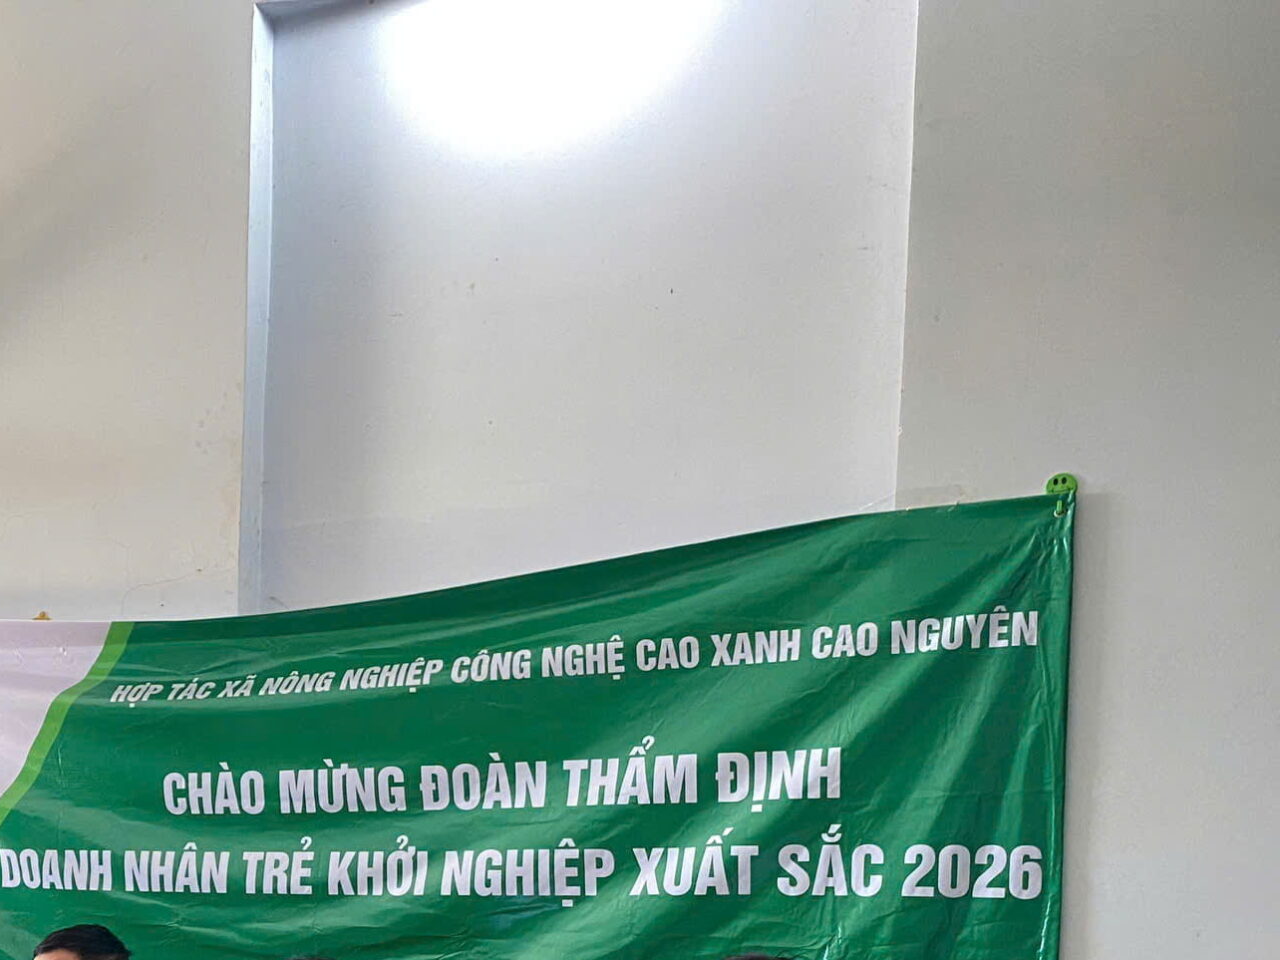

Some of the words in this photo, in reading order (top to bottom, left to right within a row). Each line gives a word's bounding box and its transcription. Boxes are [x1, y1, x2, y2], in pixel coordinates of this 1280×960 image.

[111, 682, 163, 708] HỢP
[167, 678, 214, 700] TÁC
[217, 674, 256, 698] XÃ
[258, 670, 336, 696] NÔNG
[339, 657, 443, 693] NGHIỆP
[450, 649, 531, 684] CÔNG
[541, 635, 625, 680] NGHỆ
[636, 635, 700, 672] CAO
[710, 628, 801, 667] XANH
[811, 622, 879, 659] CAO
[891, 605, 1039, 655] NGUYÊN
[163, 761, 265, 815] CHÀO
[279, 757, 407, 814] MỪNG
[419, 752, 547, 812] ĐOÀN
[563, 735, 698, 807] THẨM
[715, 747, 842, 813] ĐỊNH
[124, 842, 230, 894] NHÂN
[242, 836, 315, 895] TRẺ
[327, 834, 429, 897] KHỞI
[440, 837, 615, 907] NGHIỆP
[629, 827, 759, 896] XUẤT
[777, 823, 885, 898] SẮC
[901, 844, 1044, 900] 2026
